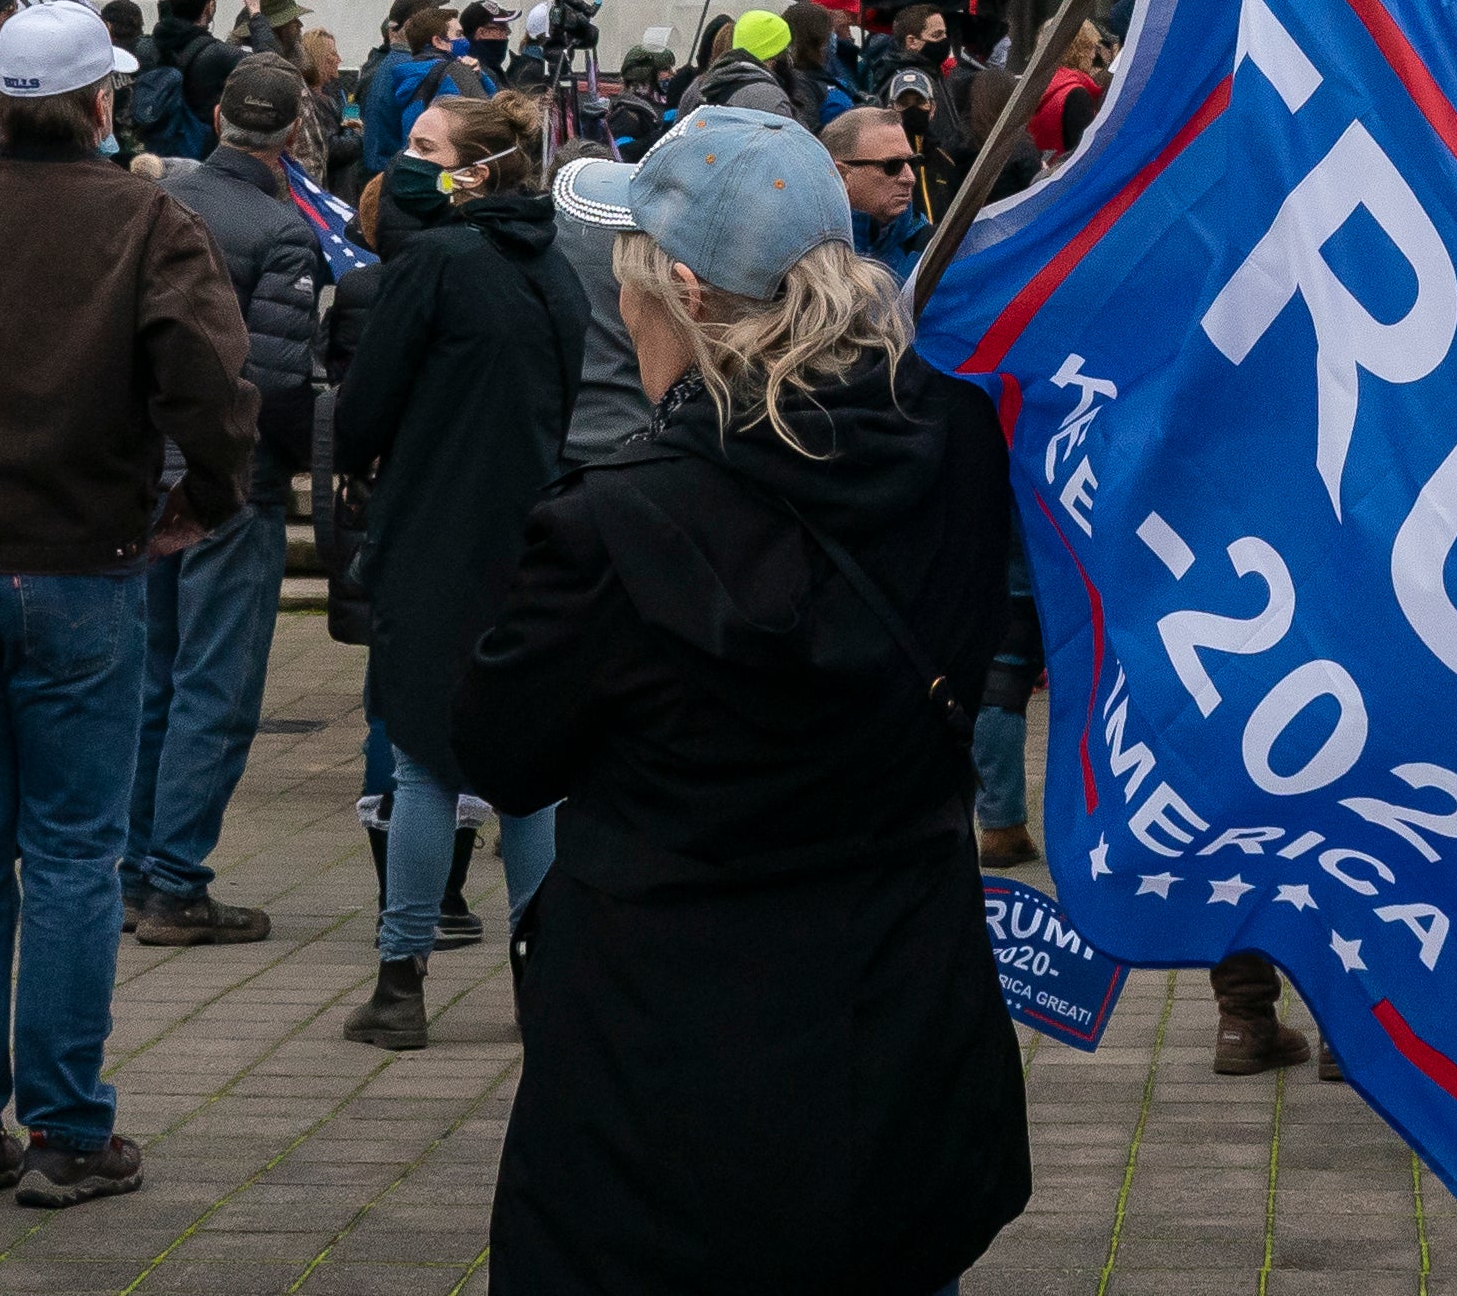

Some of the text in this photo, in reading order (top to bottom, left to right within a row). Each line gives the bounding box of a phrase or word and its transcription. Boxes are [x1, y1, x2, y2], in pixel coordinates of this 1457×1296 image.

[1045, 353, 1118, 539] KEE
[1103, 659, 1450, 972] MERICA
[985, 899, 1094, 961] RUM
[998, 974, 1093, 1026] RICA GREAT!
